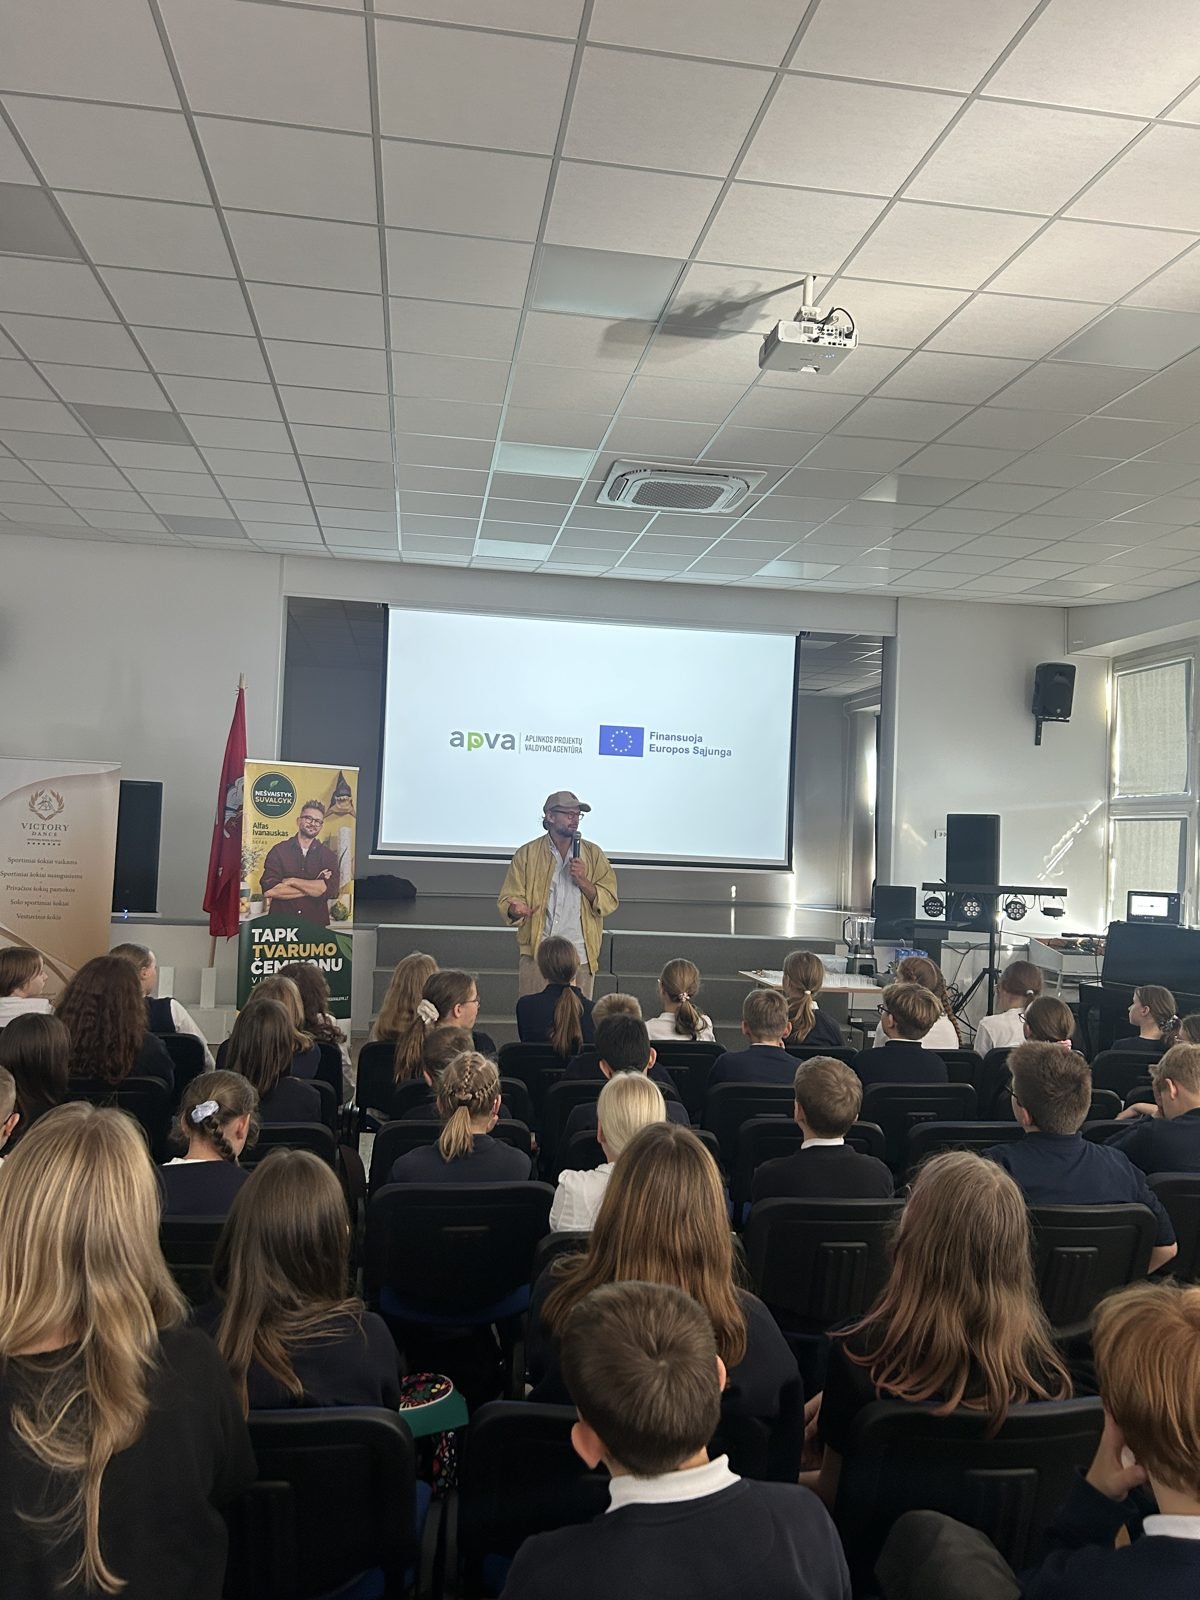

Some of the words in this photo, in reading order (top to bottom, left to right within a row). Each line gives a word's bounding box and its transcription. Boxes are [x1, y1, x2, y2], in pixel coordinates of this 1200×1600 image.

[449, 730, 516, 752] apva
[525, 735, 554, 744] APLINKOS
[554, 736, 583, 746] PROJEKTŲ
[649, 731, 703, 744] Finansuoja
[524, 744, 552, 753] VALDYMO
[552, 744, 583, 754] AGENTŪRA
[649, 744, 690, 755] Europos
[692, 746, 732, 758] Sąjunga
[255, 790, 293, 798] NEŠVAISTYK
[255, 796, 292, 805] SUVALGYK
[21, 822, 70, 831] VICTORY
[252, 829, 289, 837] Ivanauskas
[251, 928, 299, 942] TAPK
[252, 943, 337, 958] TVARUMO
[250, 957, 343, 975] ČEMNU
